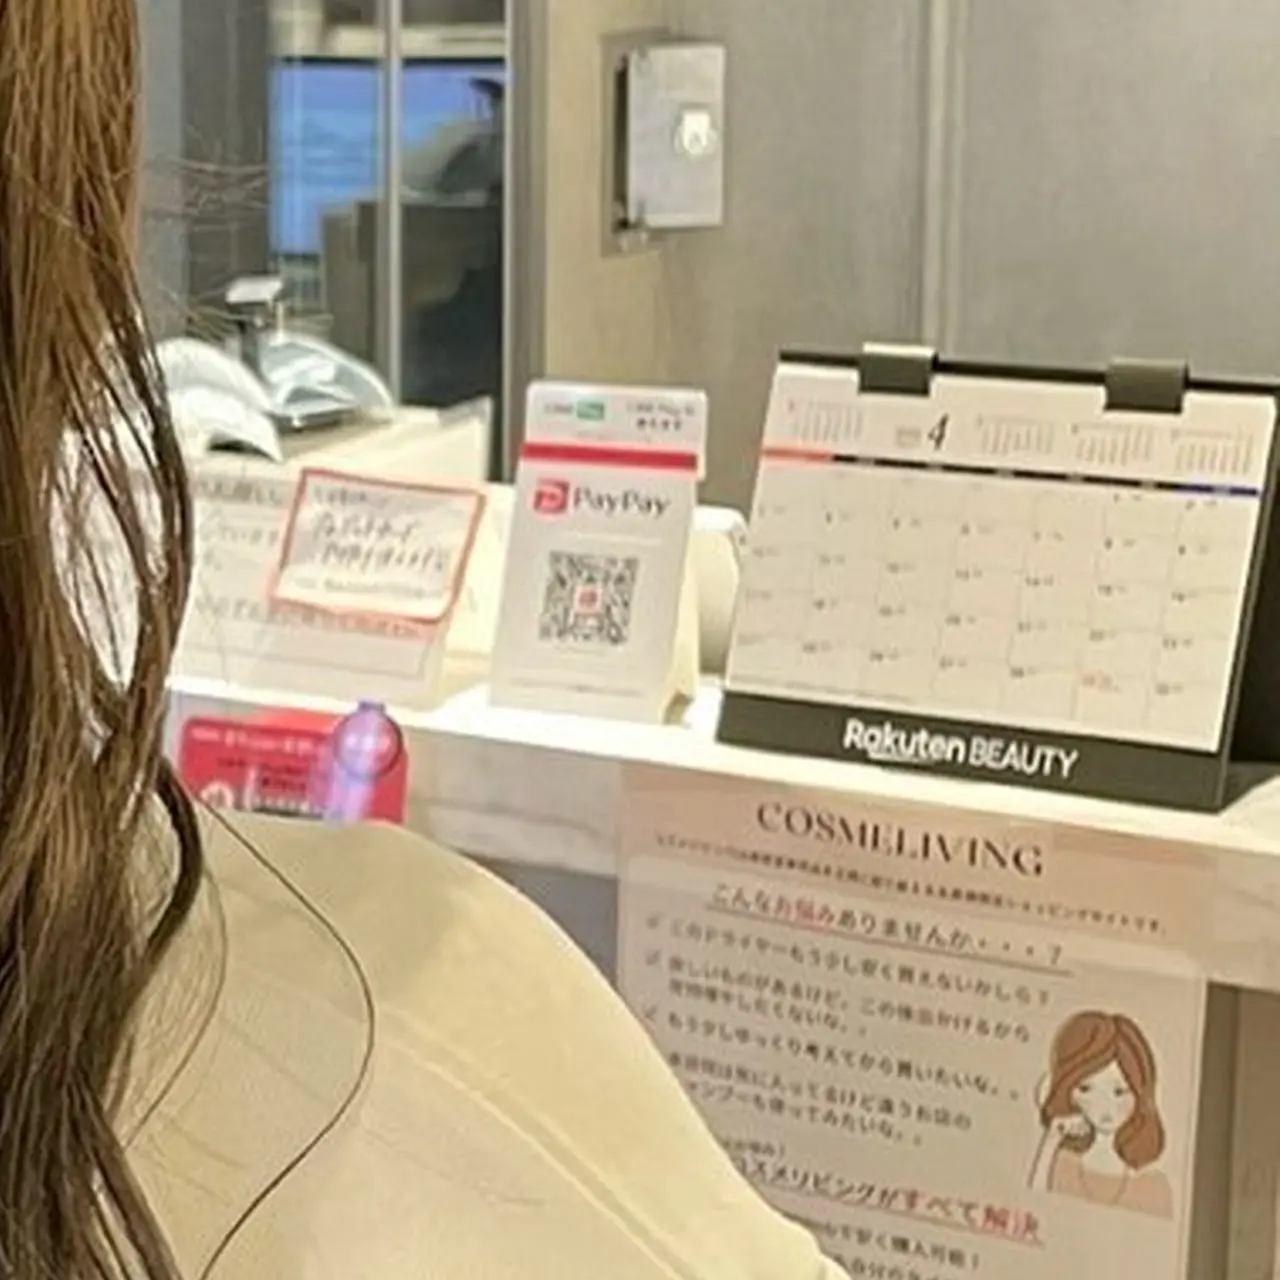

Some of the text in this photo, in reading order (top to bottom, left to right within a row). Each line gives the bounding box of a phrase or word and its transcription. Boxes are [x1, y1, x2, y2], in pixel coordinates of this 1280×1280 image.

[927, 413, 950, 450] 4
[573, 485, 672, 518] PayPay
[843, 717, 1079, 779] Rakuten BEAUTY
[755, 800, 1044, 878] COSMELIVING
